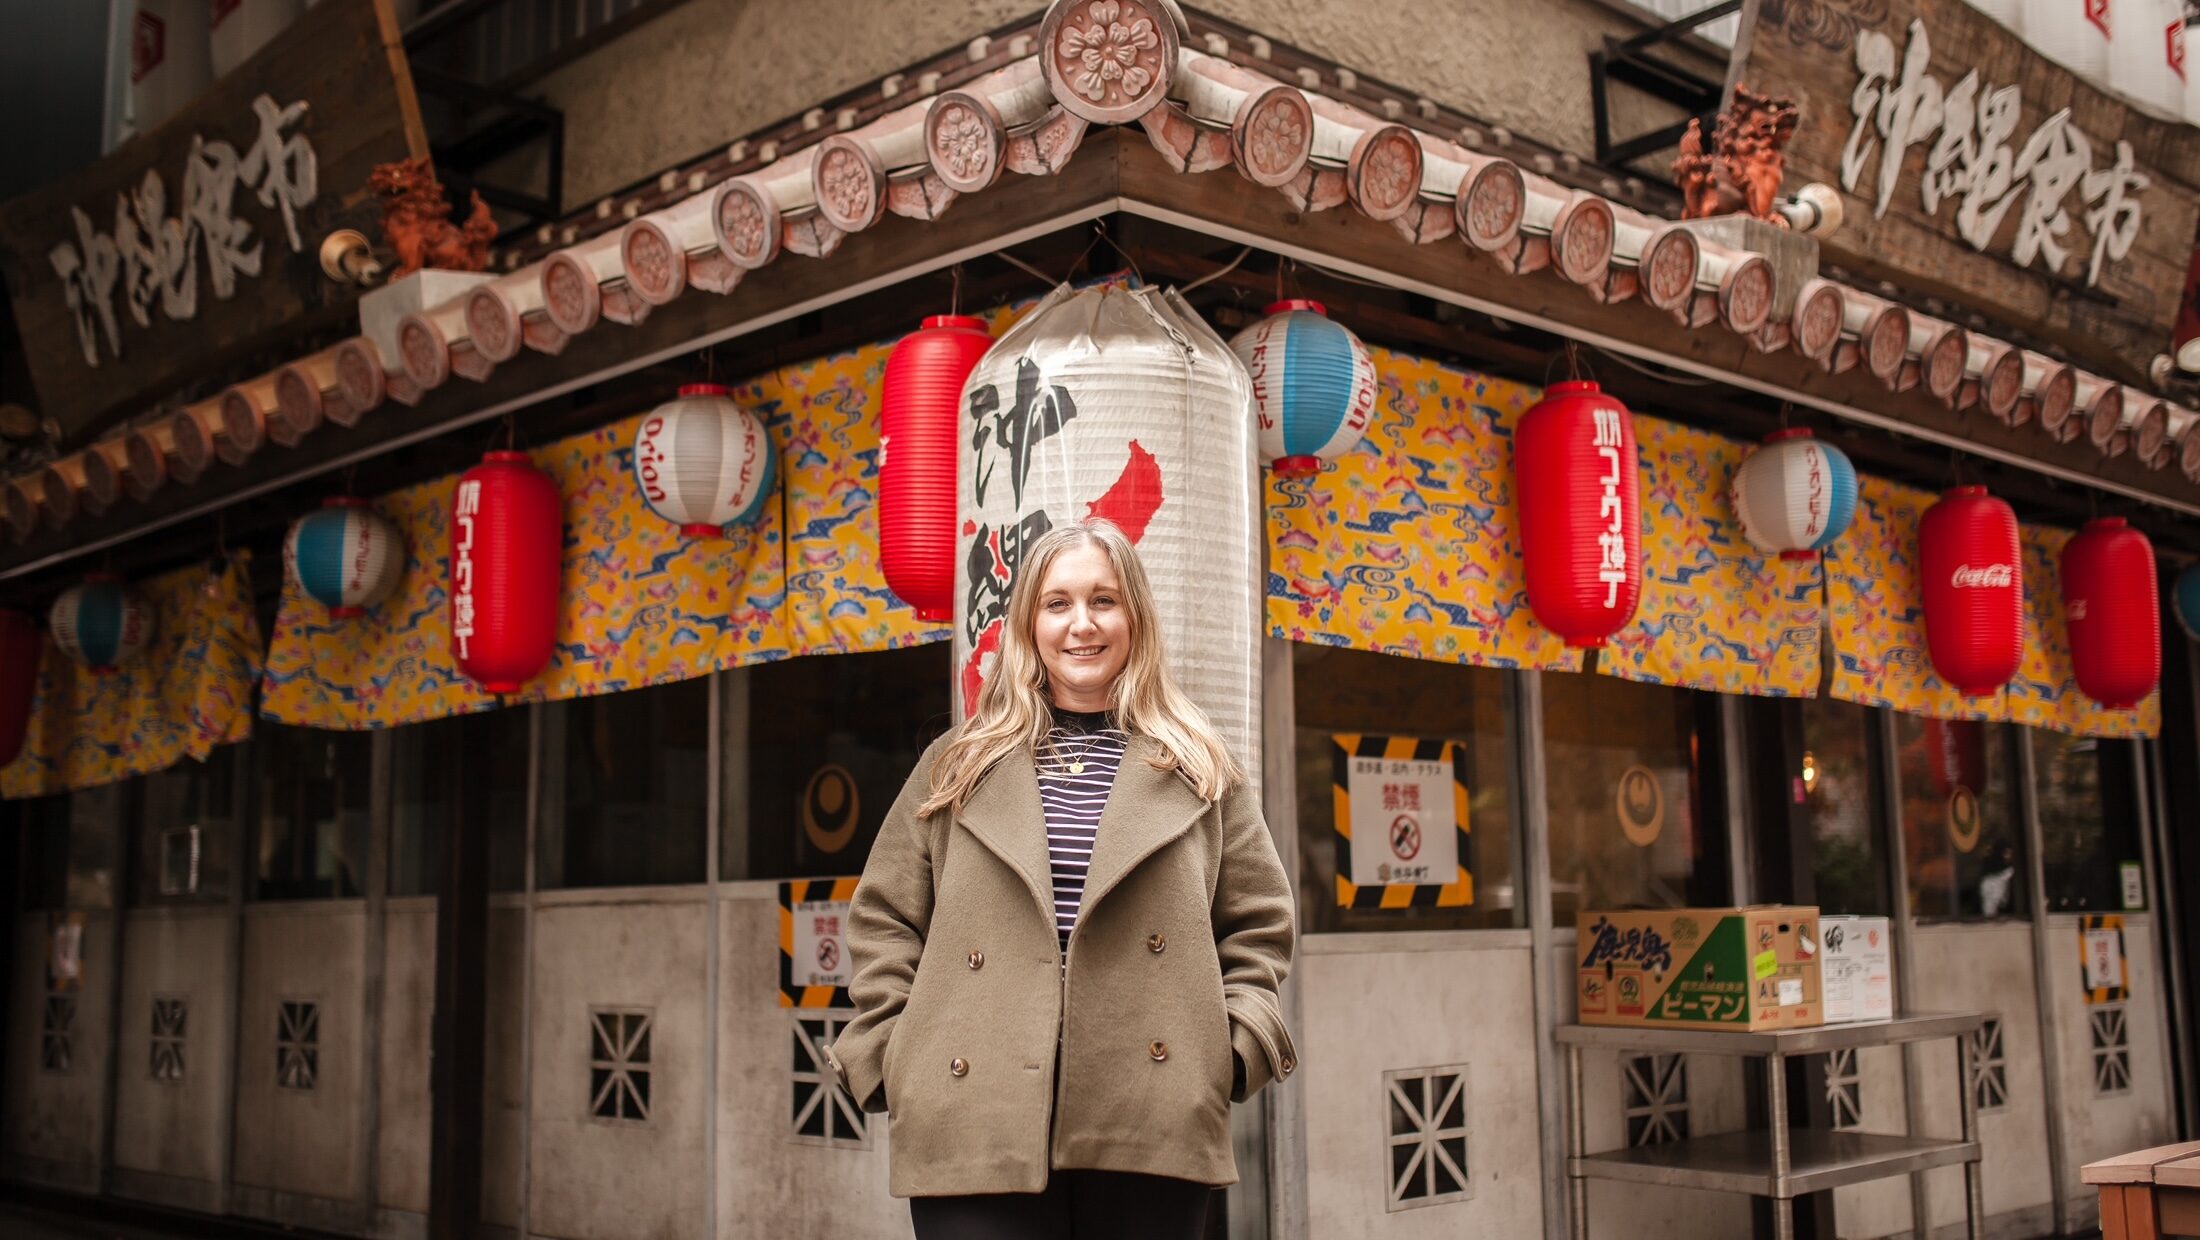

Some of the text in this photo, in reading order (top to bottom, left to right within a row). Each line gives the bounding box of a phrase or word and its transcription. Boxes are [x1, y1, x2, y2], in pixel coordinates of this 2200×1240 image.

[1841, 18, 2151, 288] 沖縄食市
[50, 93, 318, 368] 沖縄食市
[640, 418, 667, 503] Orion
[1952, 564, 2013, 588] Coca-Cola
[1382, 783, 1421, 812] 禁煙
[1582, 916, 1673, 971] 鹿児島
[1661, 992, 1747, 1021] ピーマン
